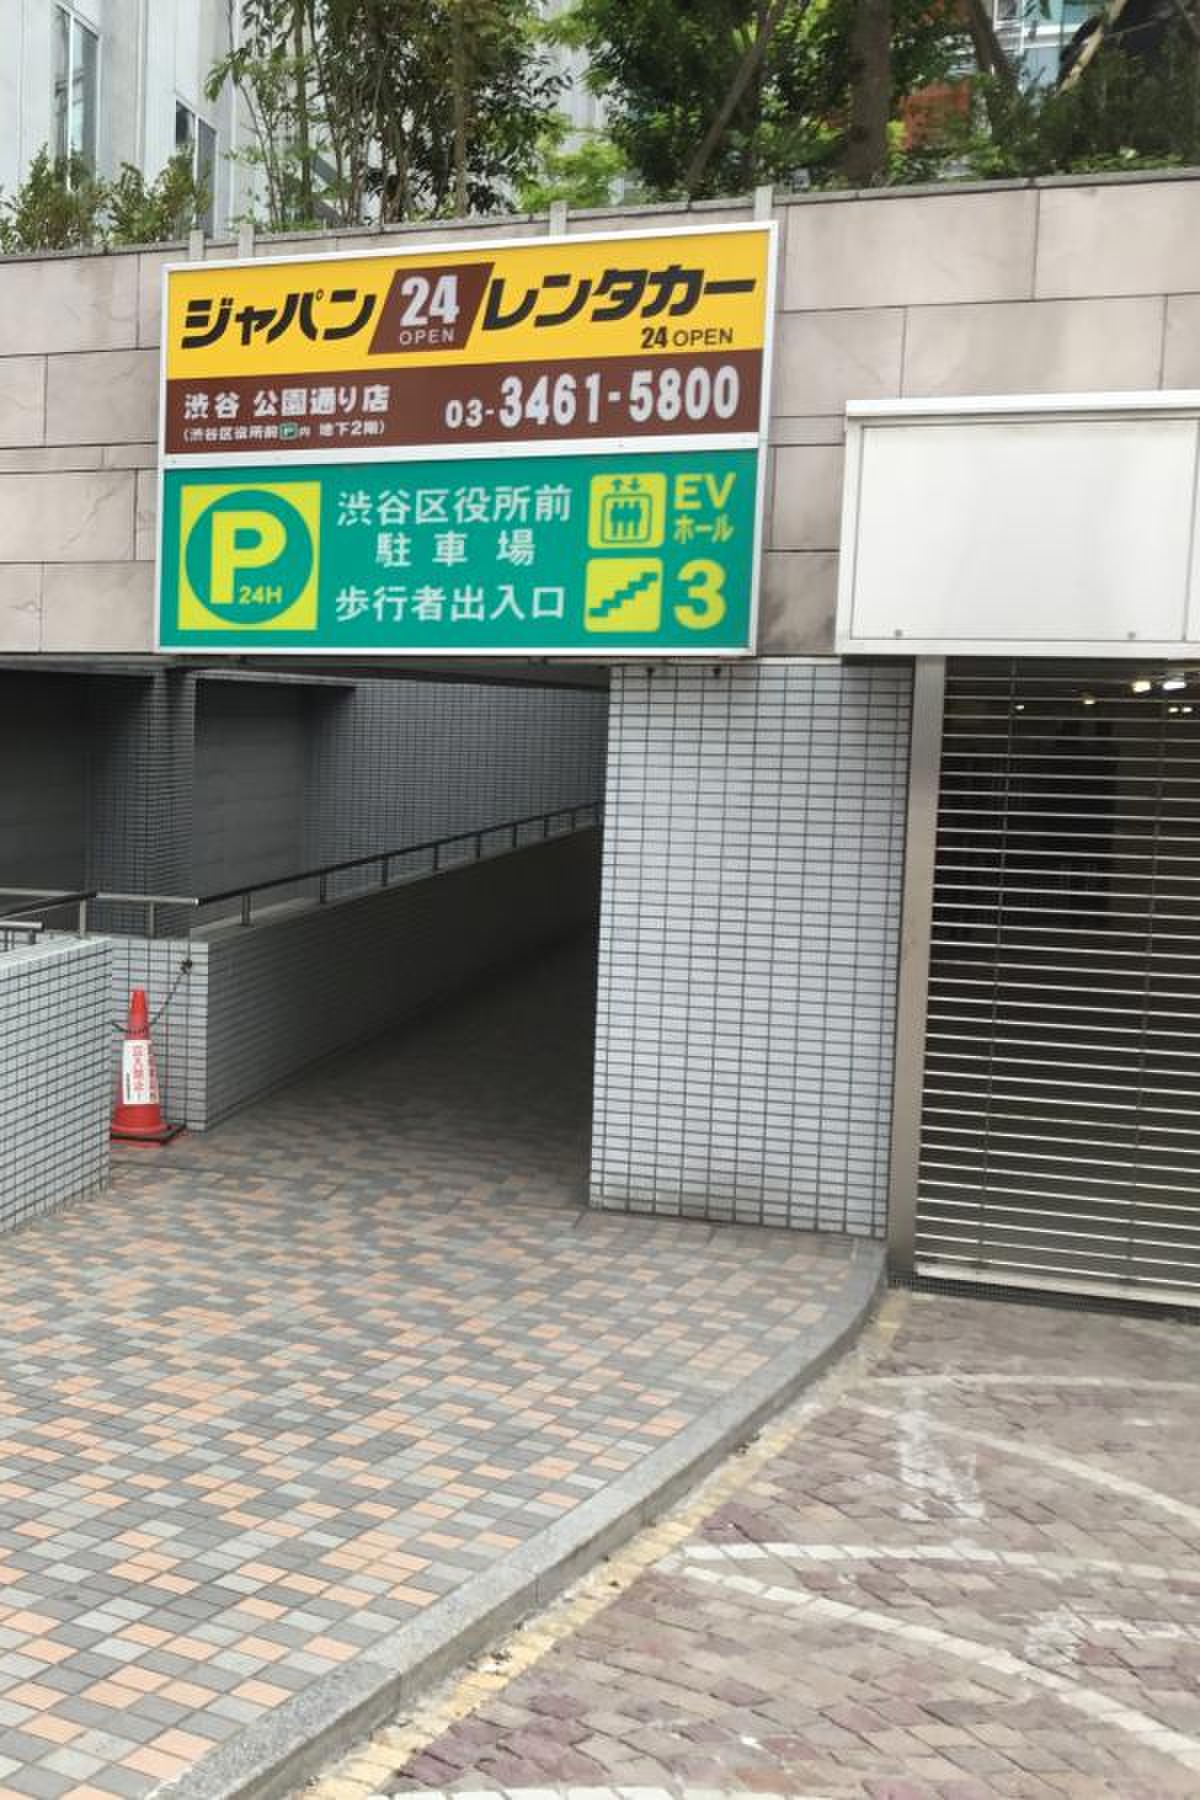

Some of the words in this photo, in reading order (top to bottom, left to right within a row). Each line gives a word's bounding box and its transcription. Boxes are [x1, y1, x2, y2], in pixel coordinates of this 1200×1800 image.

[181, 289, 377, 349] ジャパン
[400, 276, 461, 327] 24
[483, 265, 757, 331] レンタカー
[399, 328, 455, 347] OPEN
[641, 327, 668, 349] 24
[673, 328, 734, 348] OPEN
[184, 391, 240, 420] 渋谷
[253, 384, 390, 417] 公園通り店
[337, 484, 572, 528] 渋谷区役所前
[674, 472, 737, 510] EV
[673, 514, 736, 545] ホール
[210, 510, 288, 605] P
[238, 586, 282, 606] 24H
[335, 585, 566, 624] 歩行者出入口
[673, 560, 728, 630] 3
